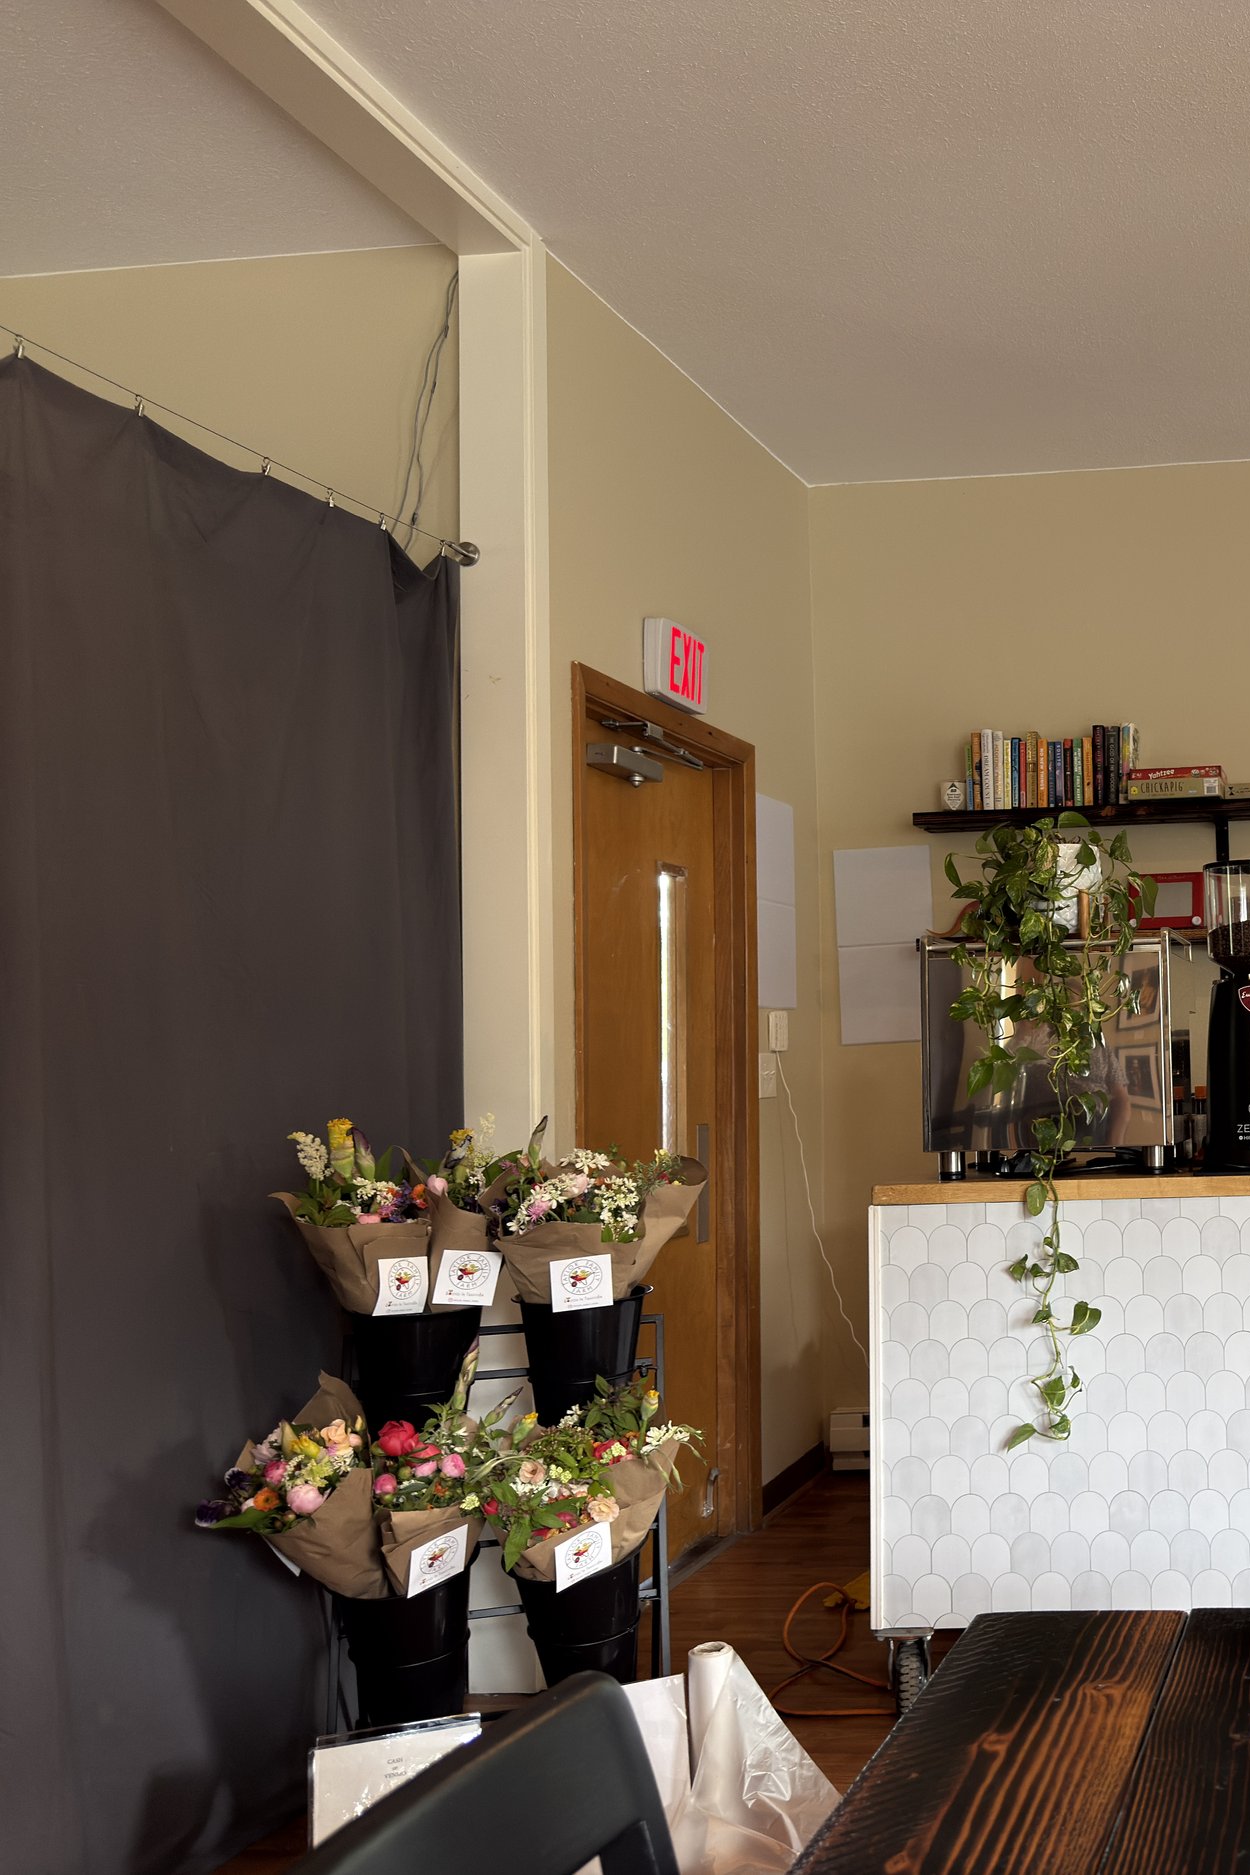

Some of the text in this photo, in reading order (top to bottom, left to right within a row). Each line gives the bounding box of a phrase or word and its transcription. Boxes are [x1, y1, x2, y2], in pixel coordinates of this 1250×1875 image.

[670, 626, 704, 705] EXIT
[1039, 748, 1045, 757] NO
[1148, 769, 1175, 780] Yahtzee
[1140, 782, 1183, 794] CHICKAPIG
